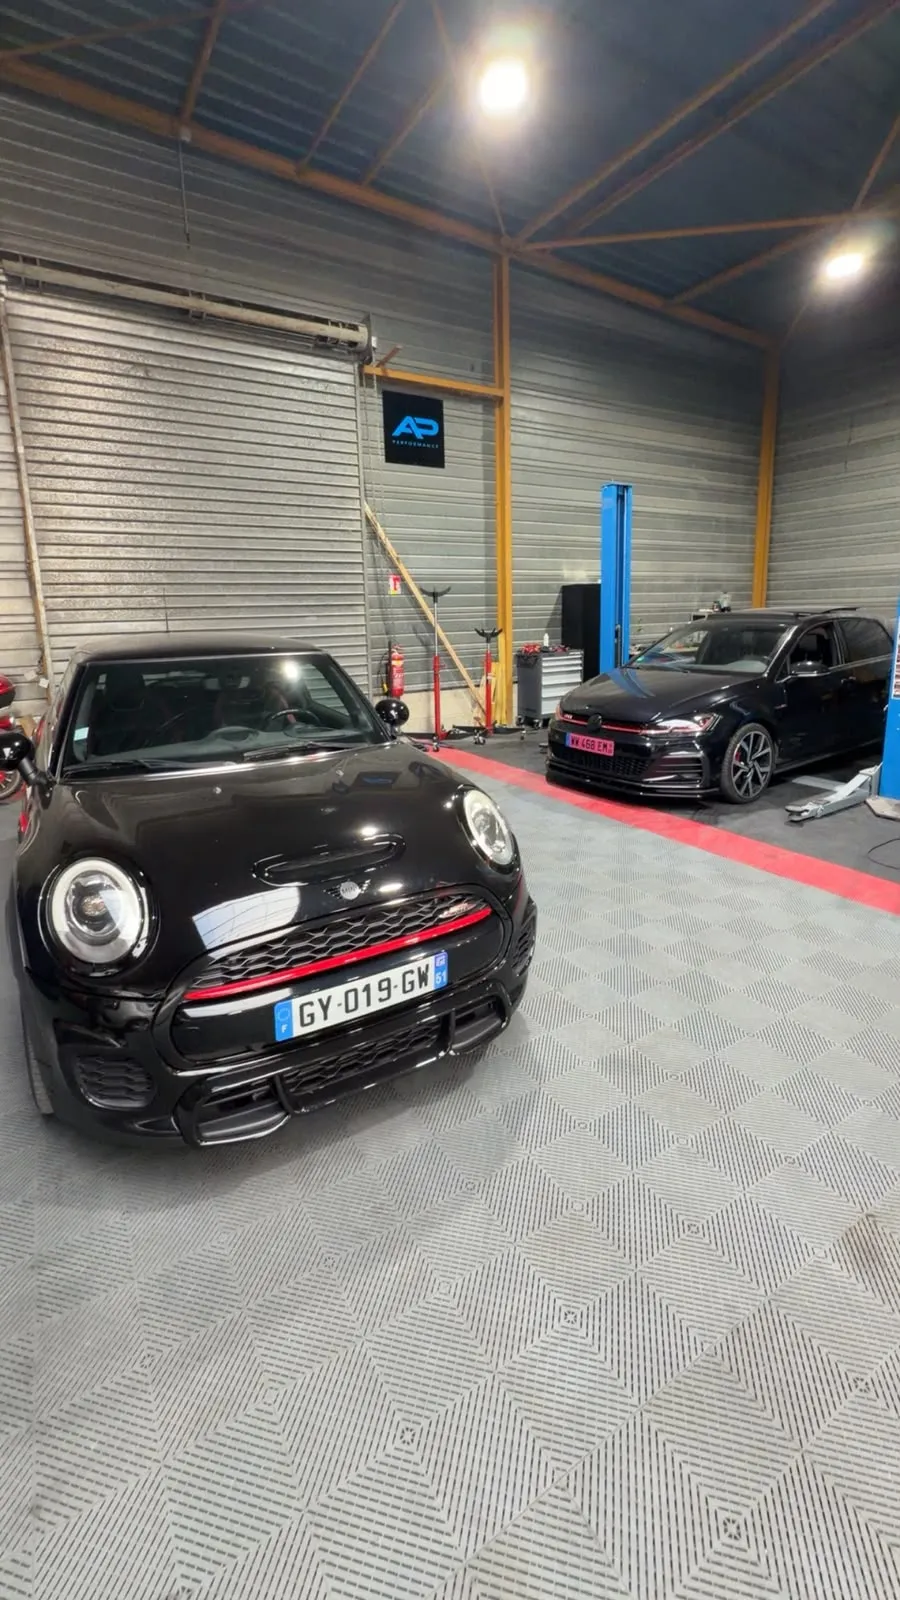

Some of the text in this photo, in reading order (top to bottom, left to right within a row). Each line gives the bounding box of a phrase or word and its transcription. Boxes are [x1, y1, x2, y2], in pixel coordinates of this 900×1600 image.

[392, 416, 439, 440] AP
[435, 971, 447, 984] 51
[299, 963, 430, 1028] GY-019-GW
[281, 1023, 288, 1034] F
